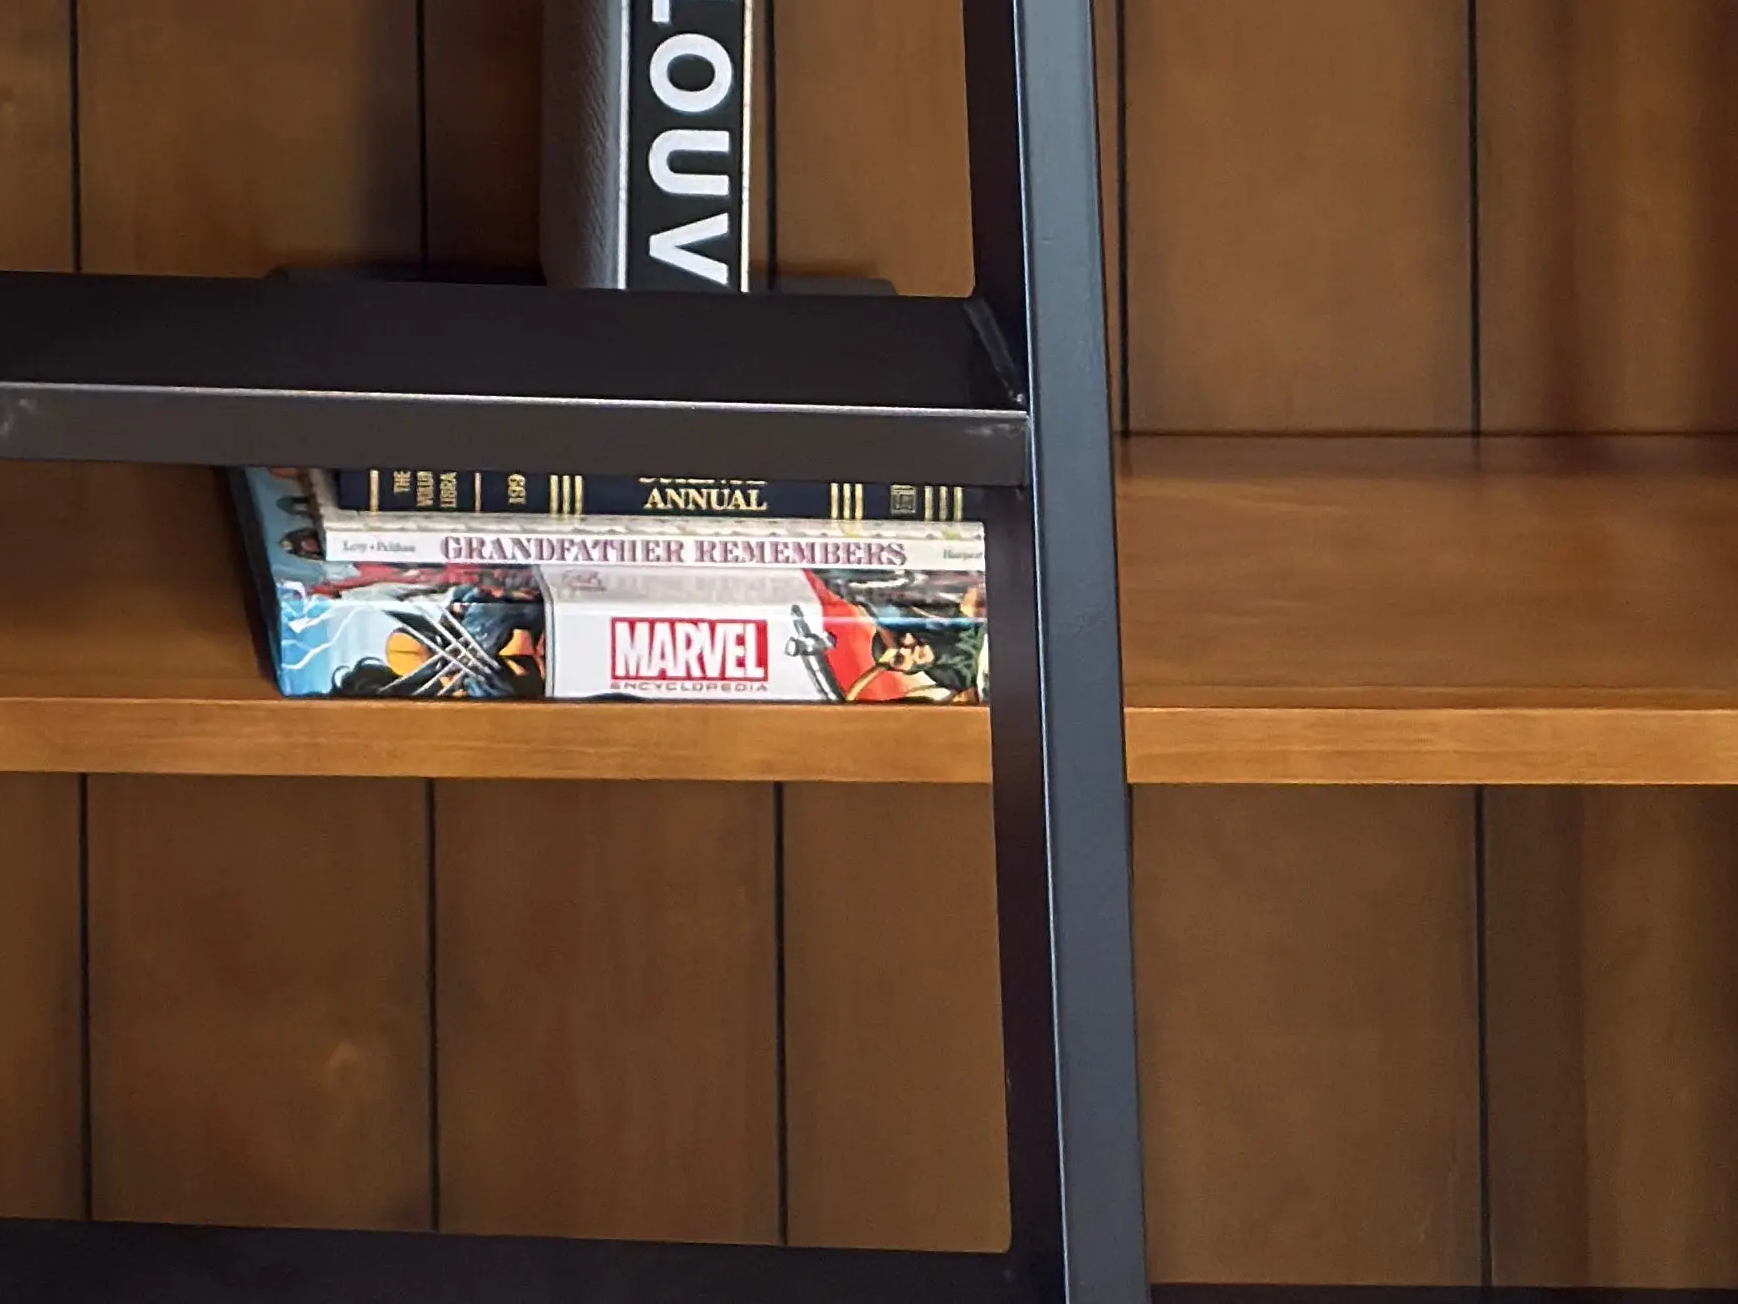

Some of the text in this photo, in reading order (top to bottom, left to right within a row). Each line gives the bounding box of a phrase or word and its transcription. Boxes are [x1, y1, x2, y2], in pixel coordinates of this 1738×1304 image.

[643, 487, 769, 511] ANNUAL
[440, 535, 685, 563] GRANDFATHER
[694, 541, 907, 566] REMEMBERS
[615, 620, 764, 679] MARVEL
[611, 682, 769, 692] ENCYCLOPEDIA
